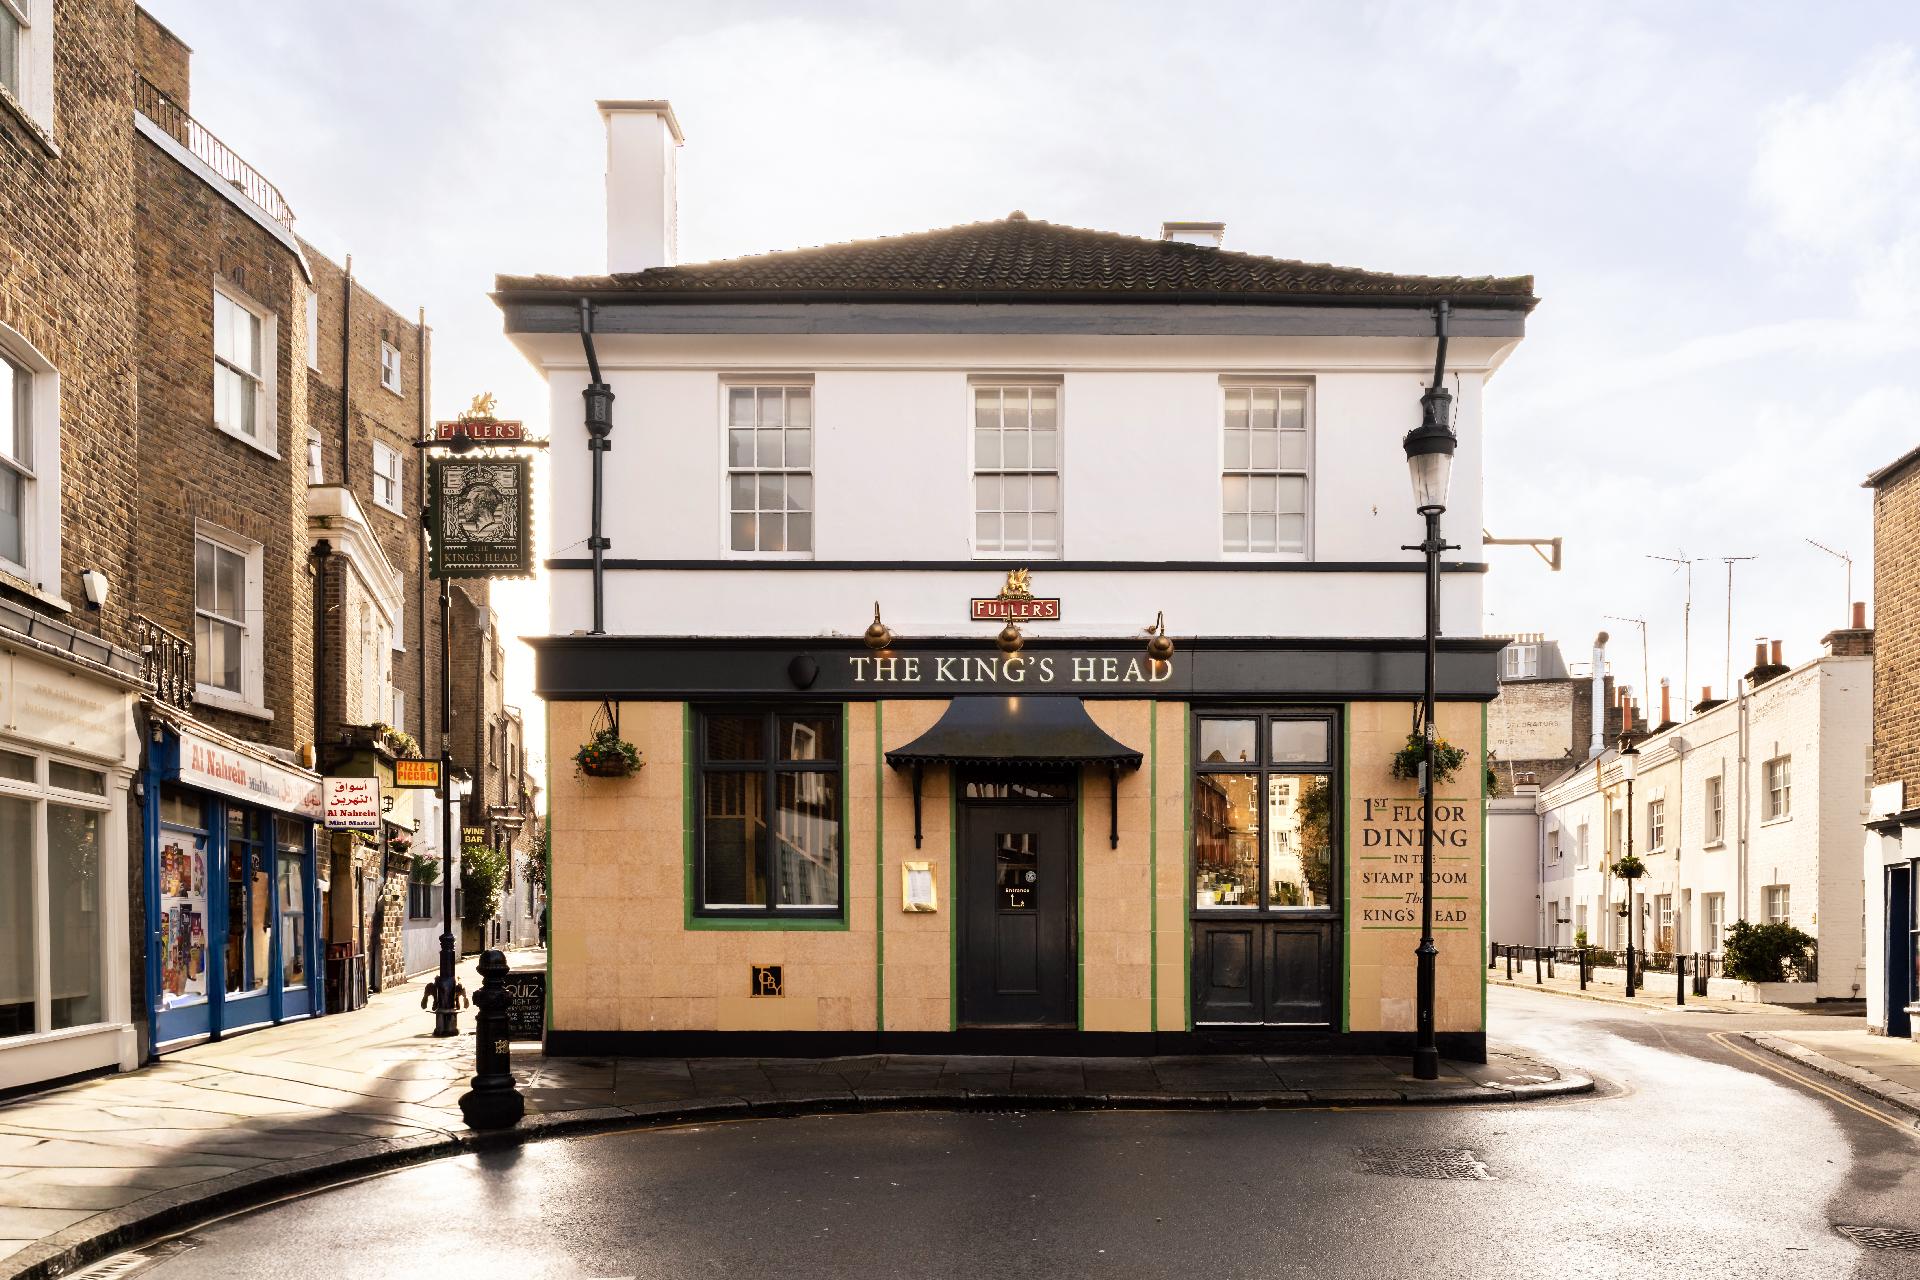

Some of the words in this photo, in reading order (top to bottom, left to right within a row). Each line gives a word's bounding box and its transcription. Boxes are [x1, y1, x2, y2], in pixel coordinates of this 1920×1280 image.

[444, 553, 480, 562] KINGS
[485, 553, 518, 562] HEAD
[976, 600, 1054, 617] FULLER'S
[849, 656, 921, 682] THE
[935, 656, 1054, 682] KING'S
[1072, 656, 1173, 682] HEAD
[191, 743, 204, 772] Al
[206, 748, 247, 786] Nahrein
[398, 762, 426, 771] PIZZA
[397, 771, 437, 781] PICCOLO
[327, 809, 338, 817] Al
[339, 809, 377, 817] Nahrein
[463, 827, 486, 835] WINE
[1363, 828, 1467, 847] DINING
[1394, 854, 1408, 864] IN
[1362, 872, 1413, 884] STAMP
[1363, 907, 1415, 922] KING'S
[1433, 910, 1467, 922] EAD
[505, 984, 538, 998] QUIZ
